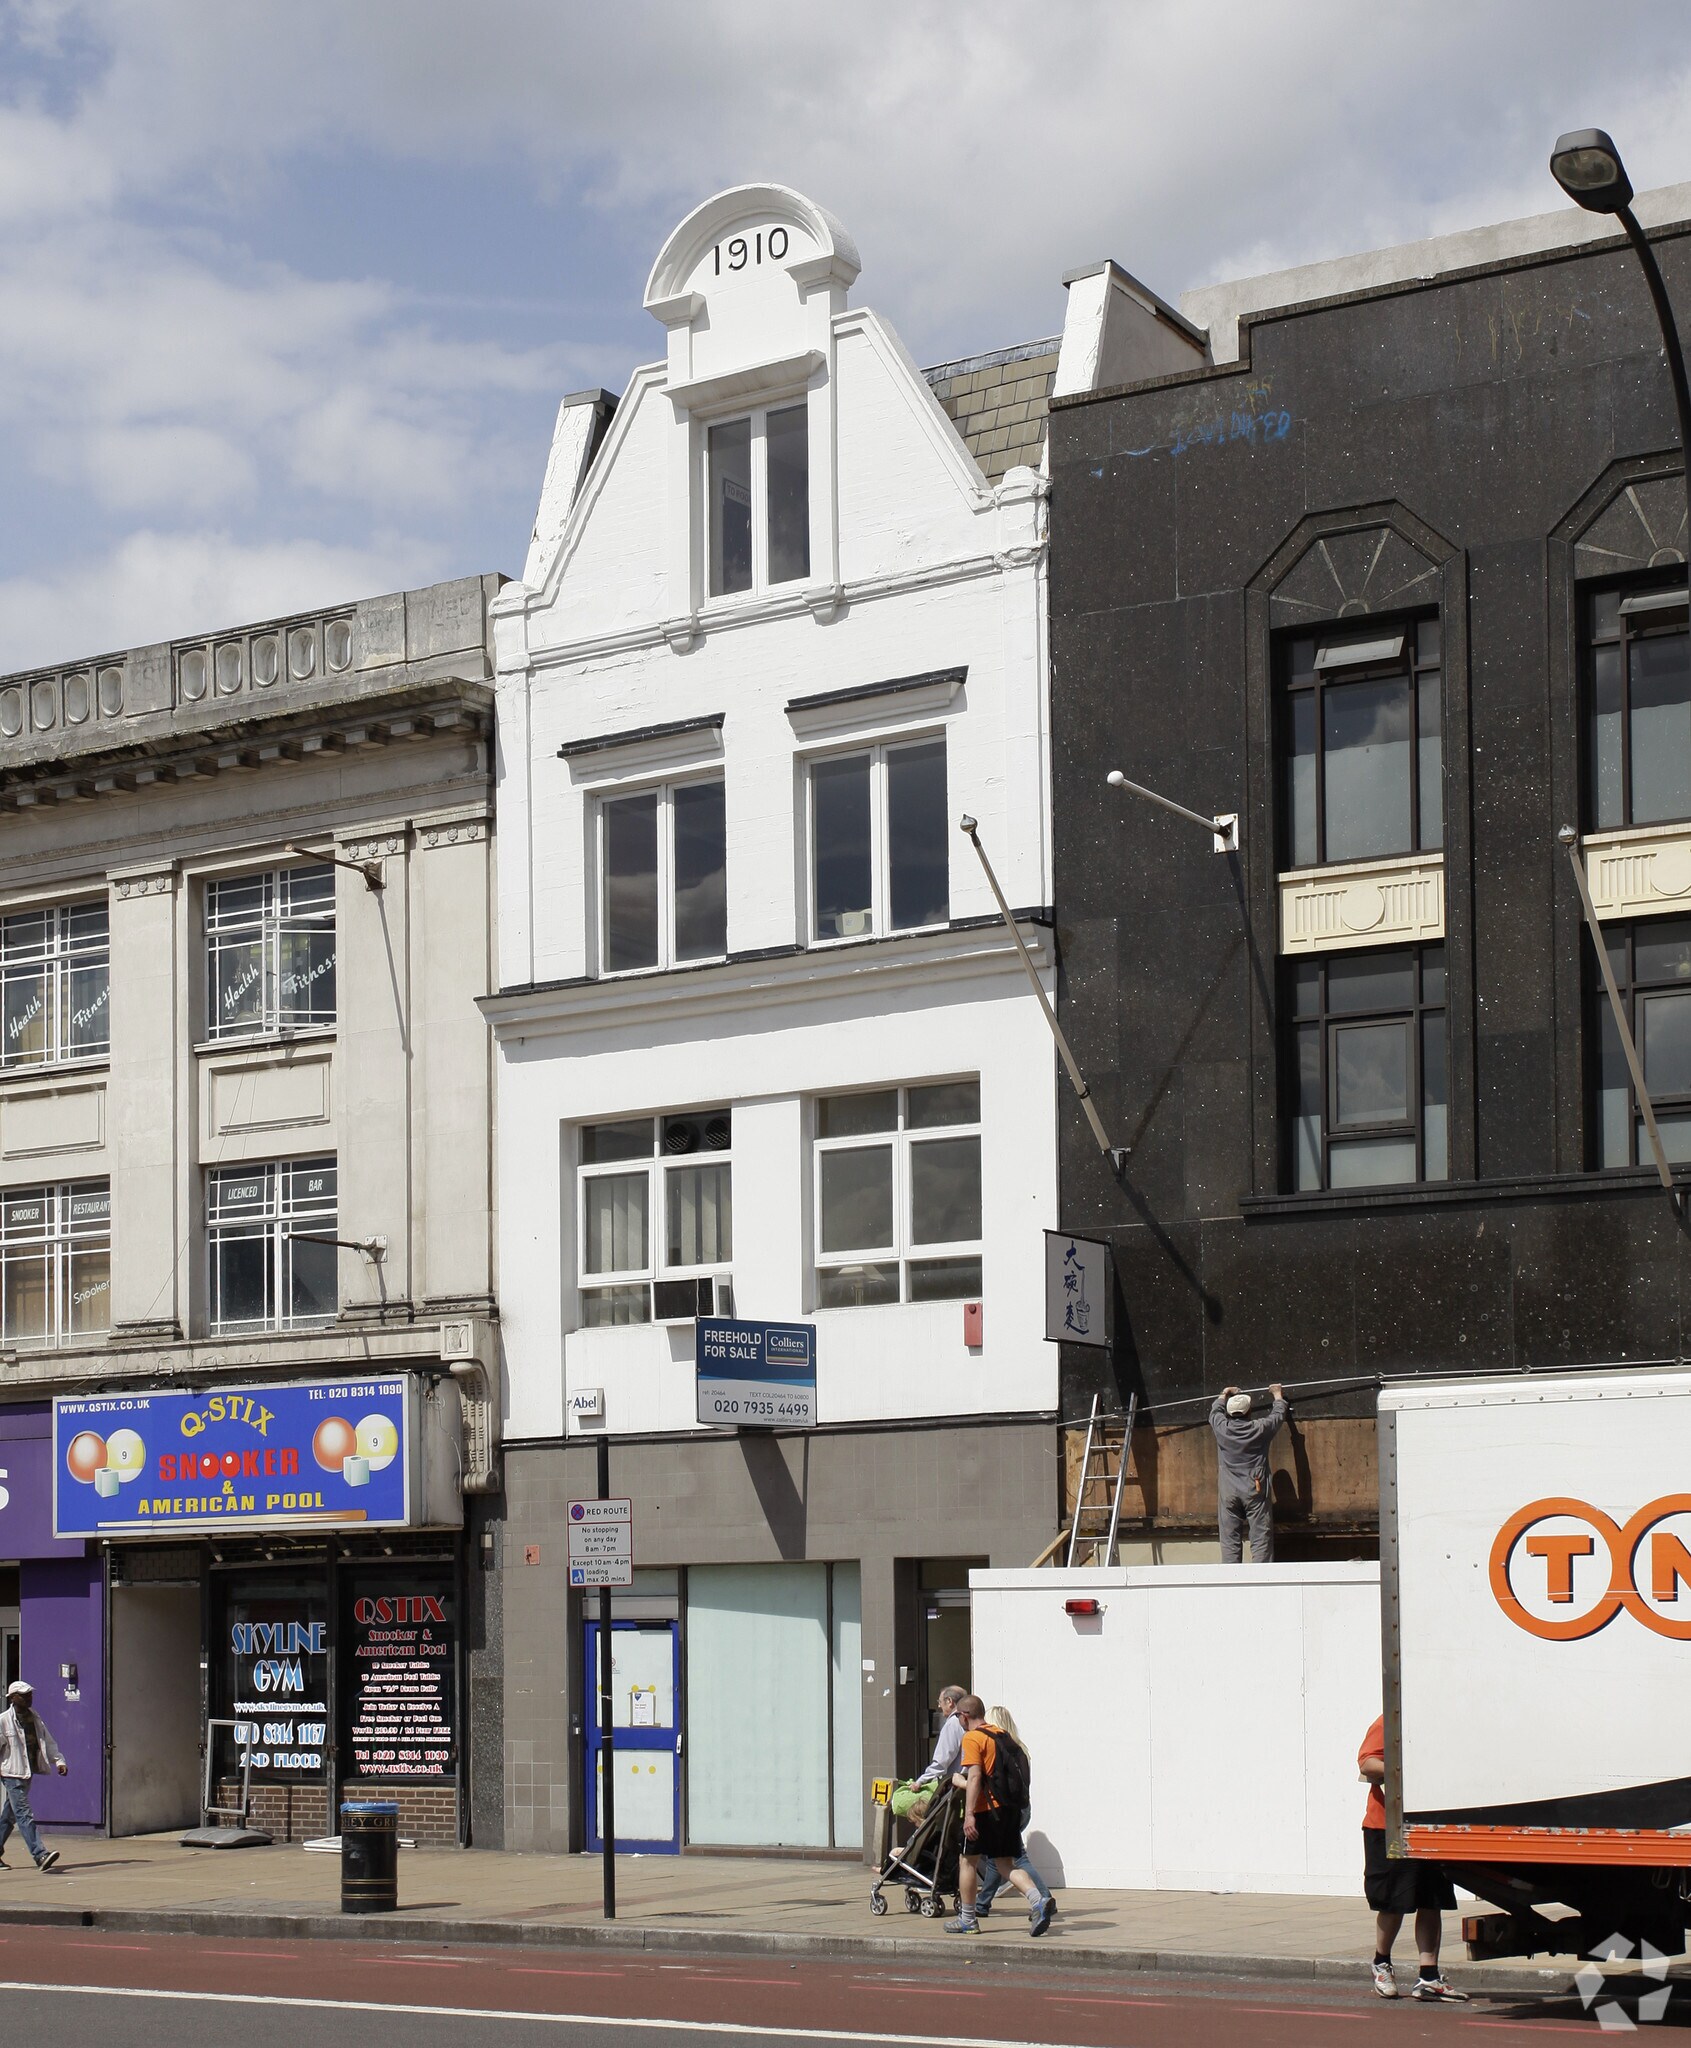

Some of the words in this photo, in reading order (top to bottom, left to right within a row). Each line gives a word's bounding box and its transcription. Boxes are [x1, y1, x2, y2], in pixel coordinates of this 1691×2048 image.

[715, 227, 789, 276] 1910
[225, 964, 260, 1009] Health
[9, 995, 42, 1039] Health
[228, 1185, 258, 1200] LICENCED
[308, 1179, 323, 1192] BAR
[11, 1207, 39, 1222] SNOOKER
[73, 1200, 111, 1215] RESTAURANT
[73, 1279, 111, 1305] Snooker
[704, 1330, 761, 1345] FREEHOLD
[770, 1336, 804, 1348] Colliers
[704, 1345, 726, 1358] FOR
[729, 1346, 757, 1359] SALE
[309, 1389, 326, 1400] TEL:
[328, 1388, 348, 1399] 020
[351, 1386, 375, 1397] 8314
[378, 1384, 402, 1395] 1090
[60, 1400, 150, 1414] WWW.QSTIX.CO.UK
[573, 1396, 597, 1409] Abel
[714, 1400, 739, 1413] 020
[743, 1401, 774, 1415] 7935
[778, 1403, 809, 1416] 4499
[180, 1395, 275, 1438] Q-STIX
[372, 1438, 379, 1447] 9
[121, 1451, 128, 1460] 9
[159, 1448, 300, 1481] SNOOKER
[222, 1480, 234, 1495] &
[138, 1495, 255, 1515] AMERICAN
[266, 1492, 324, 1510] POOL
[603, 1507, 628, 1515] ROUTE
[354, 1595, 447, 1625] QSTIX
[232, 1621, 327, 1655] SKYLINE
[368, 1629, 418, 1641] Snooker
[422, 1628, 432, 1640] &
[355, 1643, 416, 1656] American
[420, 1643, 447, 1655] Pool
[254, 1657, 304, 1692] GYM
[233, 1702, 327, 1713] www.skylinegym.co.uk
[263, 1718, 294, 1744] 8314
[297, 1723, 326, 1745] 1167
[239, 1752, 270, 1768] 2ND
[273, 1752, 322, 1768] FLOOR
[355, 1750, 369, 1760] Tel
[398, 1750, 421, 1760] 8314
[425, 1750, 449, 1760] 1090
[360, 1763, 444, 1774] www.qstix.co.uk
[875, 1783, 888, 1803] H
